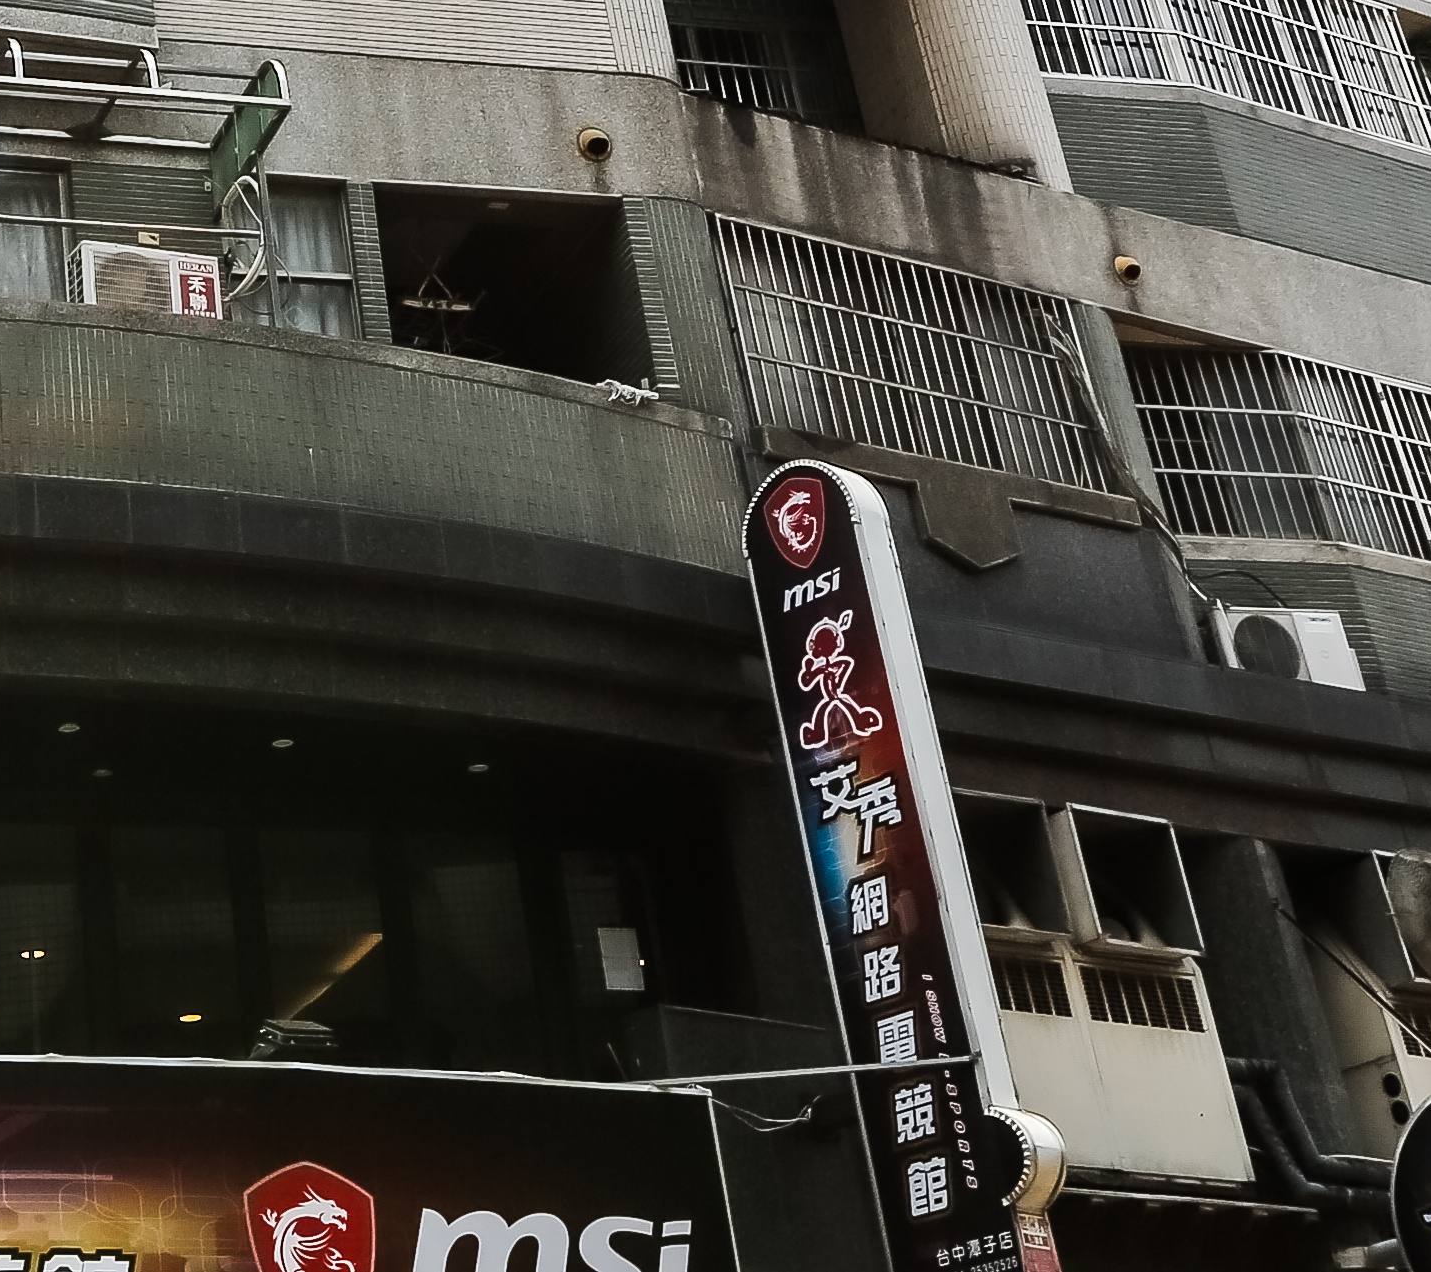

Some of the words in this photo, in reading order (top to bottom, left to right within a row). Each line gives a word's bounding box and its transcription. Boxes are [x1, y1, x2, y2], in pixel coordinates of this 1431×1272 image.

[783, 566, 841, 613] msi
[925, 990, 947, 1043] SHOW
[413, 1208, 693, 1272] msi
